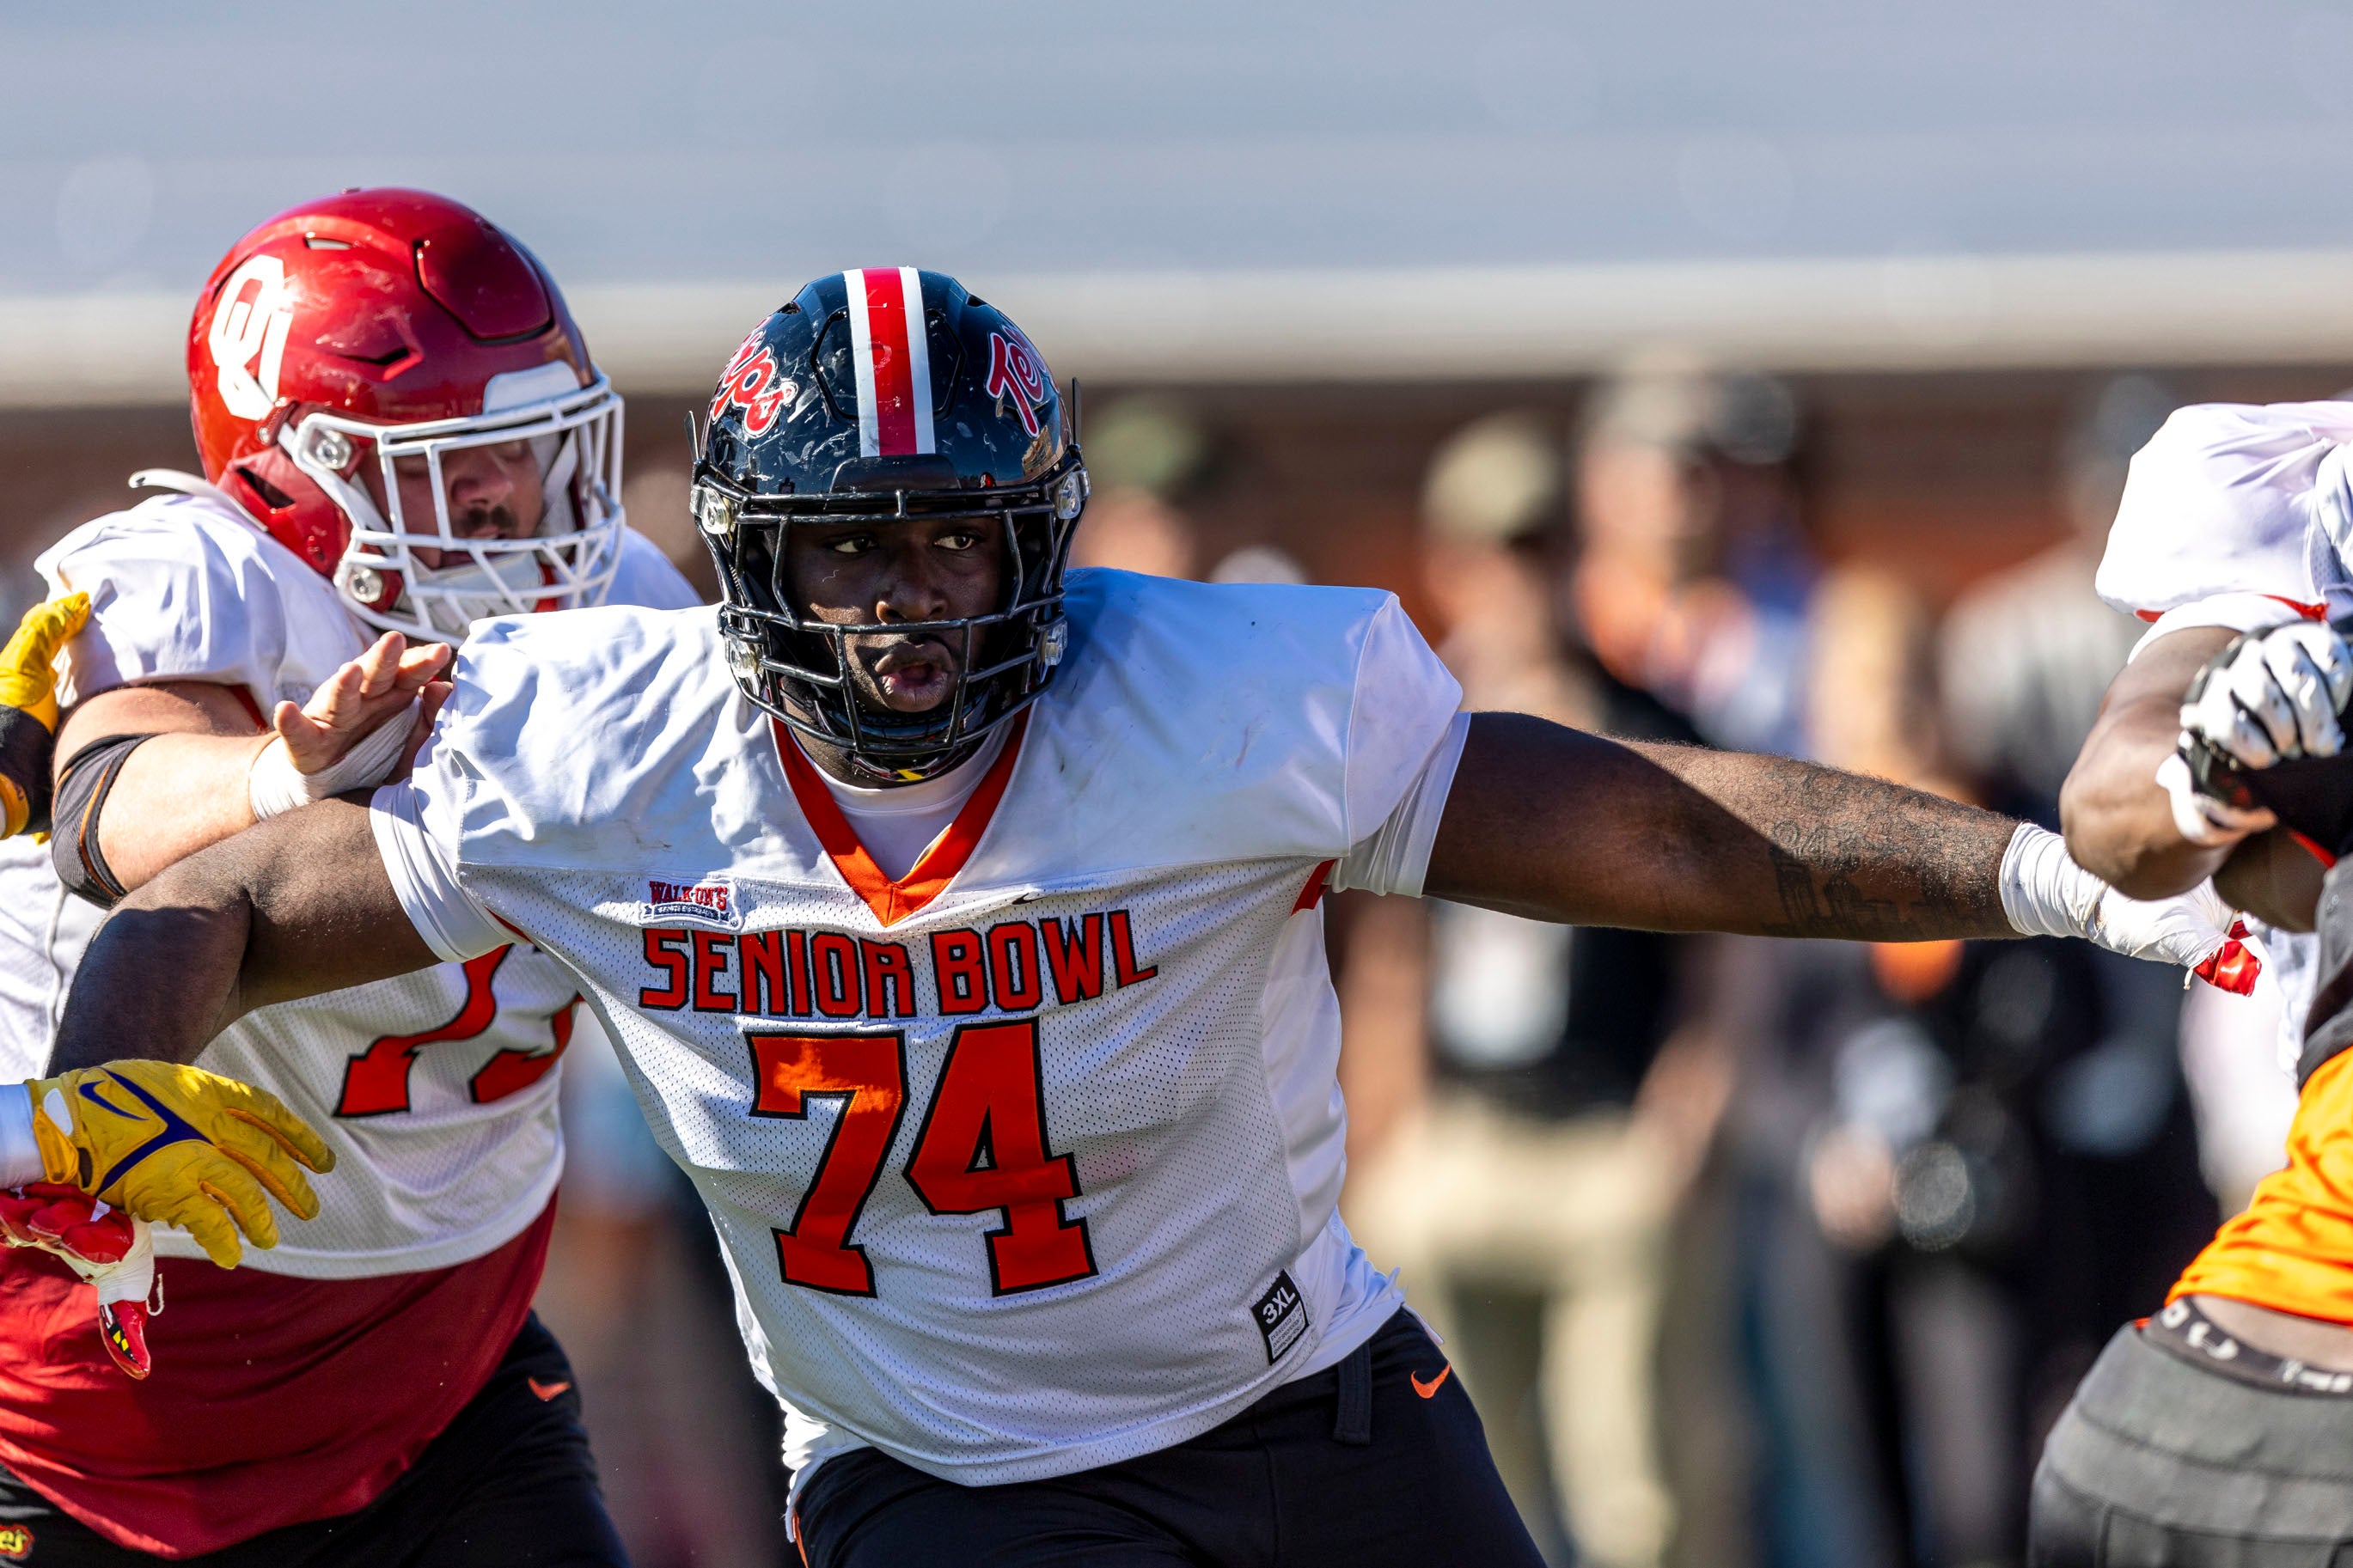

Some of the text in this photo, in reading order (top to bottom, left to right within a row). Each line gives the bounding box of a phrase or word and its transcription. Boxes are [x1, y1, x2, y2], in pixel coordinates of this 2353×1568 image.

[639, 909, 1158, 1019] SENIOR BOWL
[744, 1017, 1099, 1298] 74
[1262, 1286, 1296, 1324] 3XL
